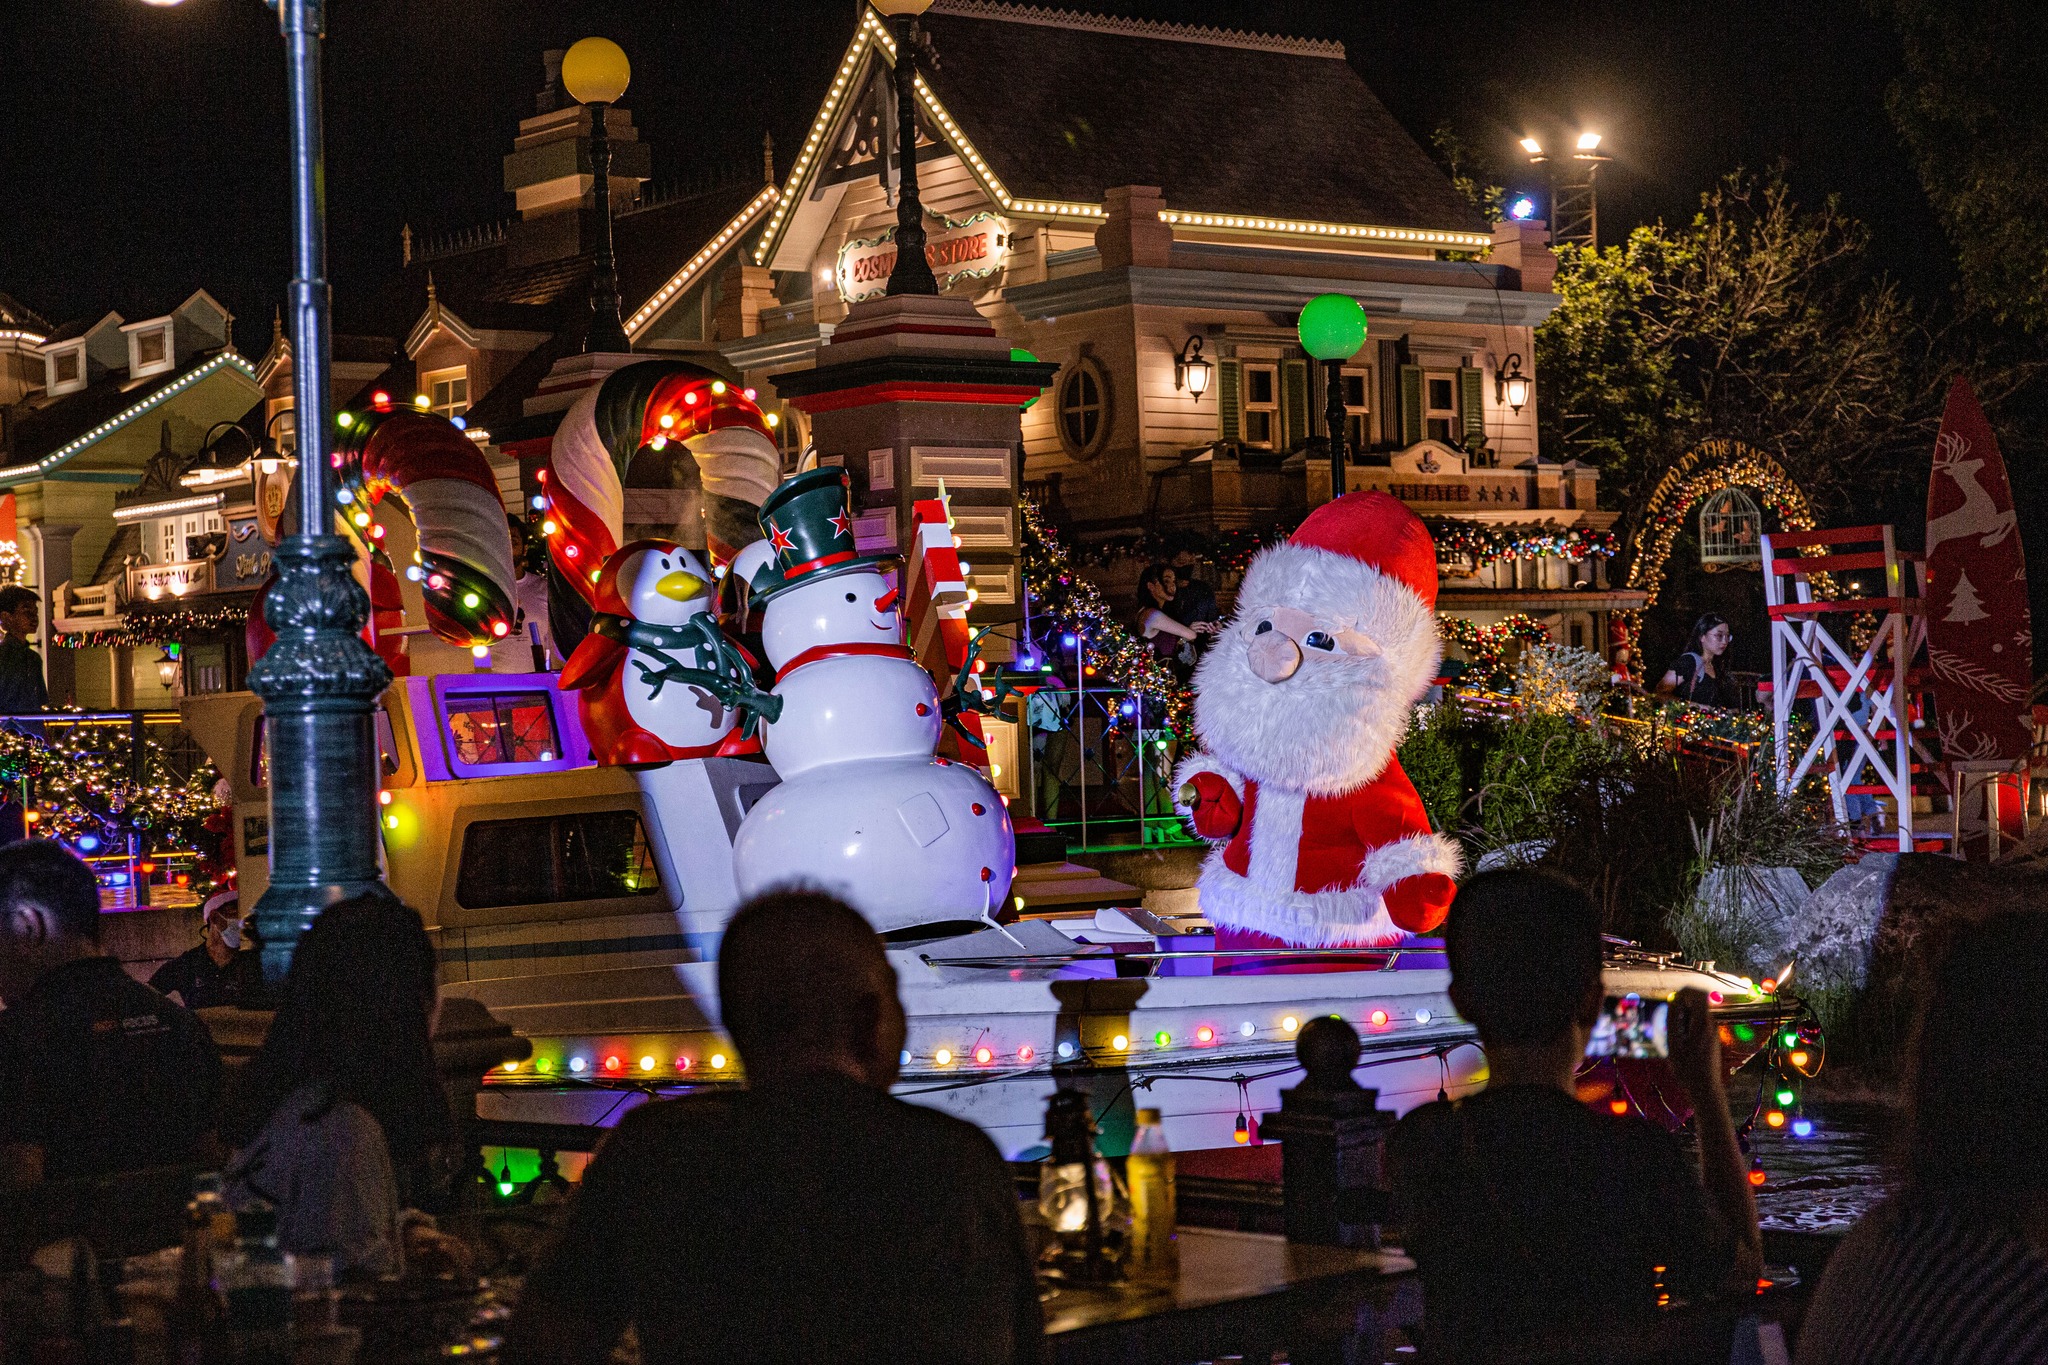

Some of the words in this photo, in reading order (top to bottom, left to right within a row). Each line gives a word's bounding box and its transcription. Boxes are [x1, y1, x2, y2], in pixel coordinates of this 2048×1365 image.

[939, 232, 988, 265] STORE
[1647, 467, 1681, 514] BIRD
[1680, 446, 1701, 472] IN
[1701, 439, 1731, 457] THE
